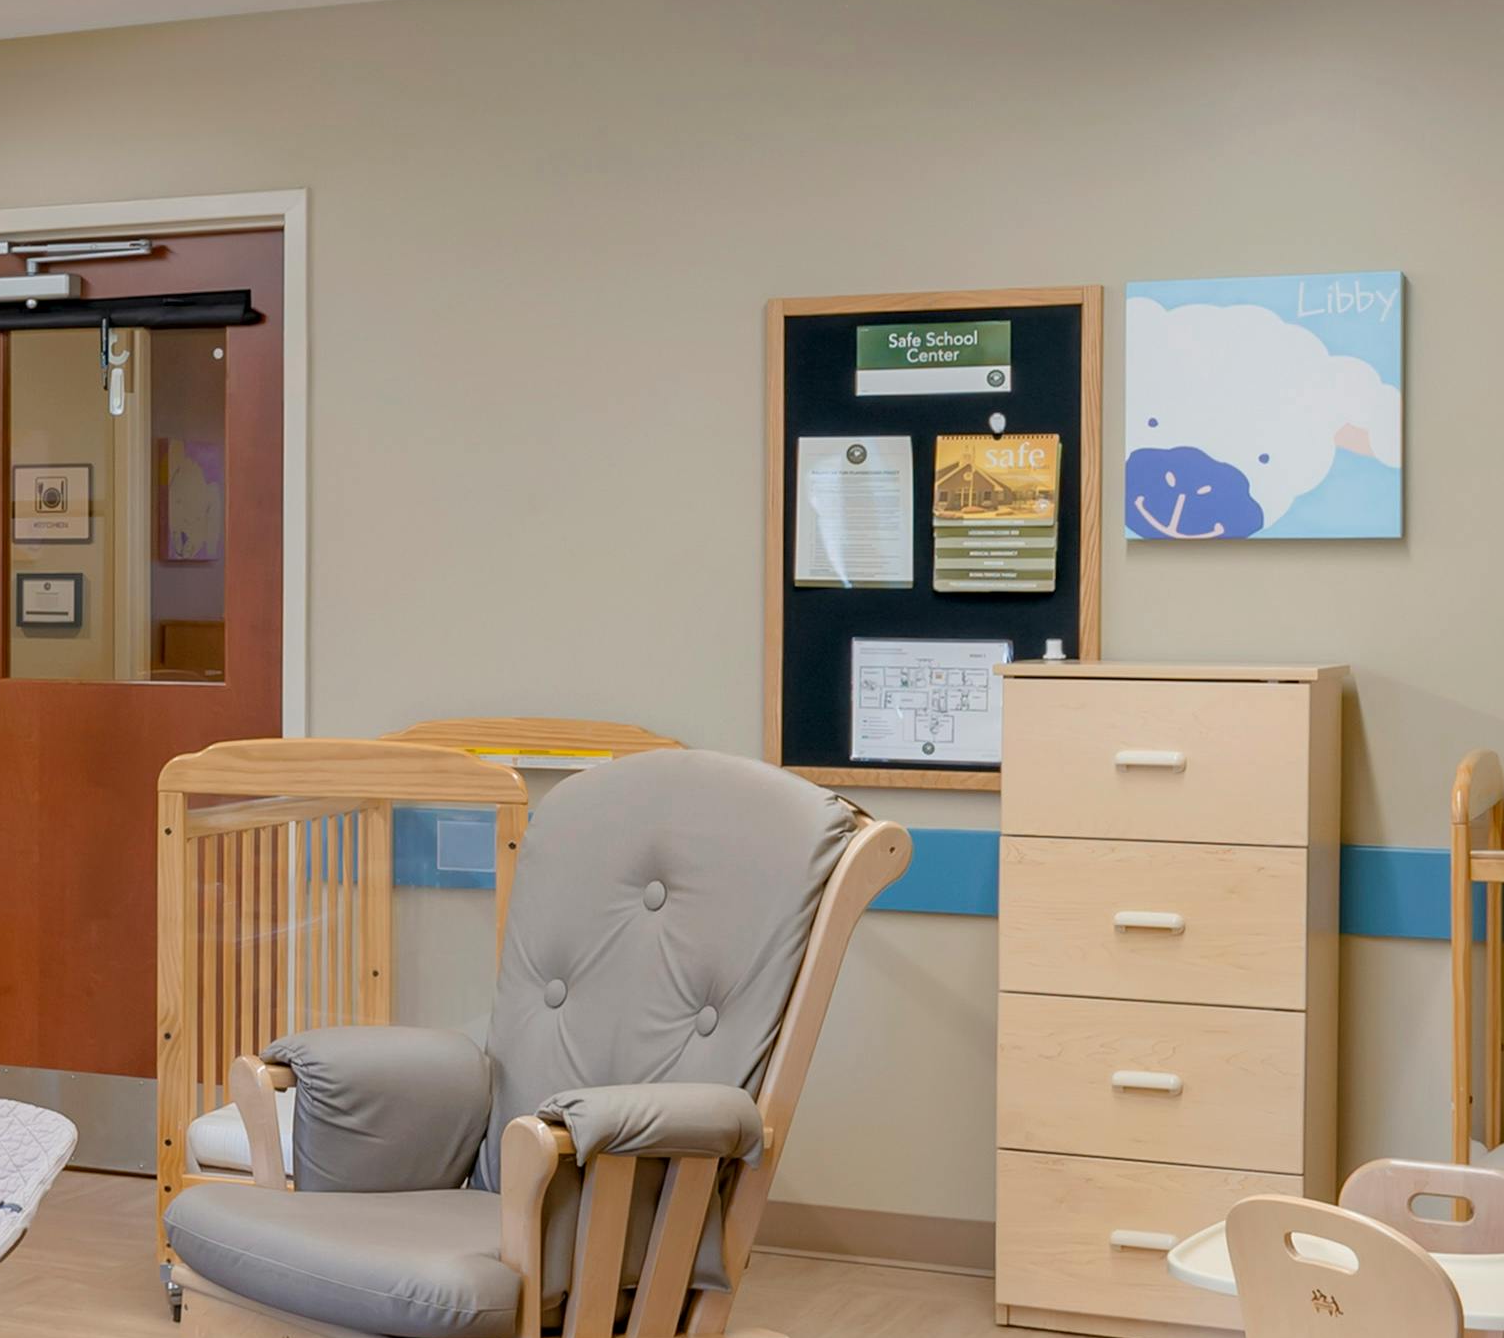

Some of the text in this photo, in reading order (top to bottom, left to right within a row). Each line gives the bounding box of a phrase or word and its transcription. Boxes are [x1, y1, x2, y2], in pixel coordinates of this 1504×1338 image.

[1295, 276, 1399, 323] Libby
[888, 329, 978, 348] Safe School
[906, 348, 960, 363] Center
[984, 442, 1046, 470] safe
